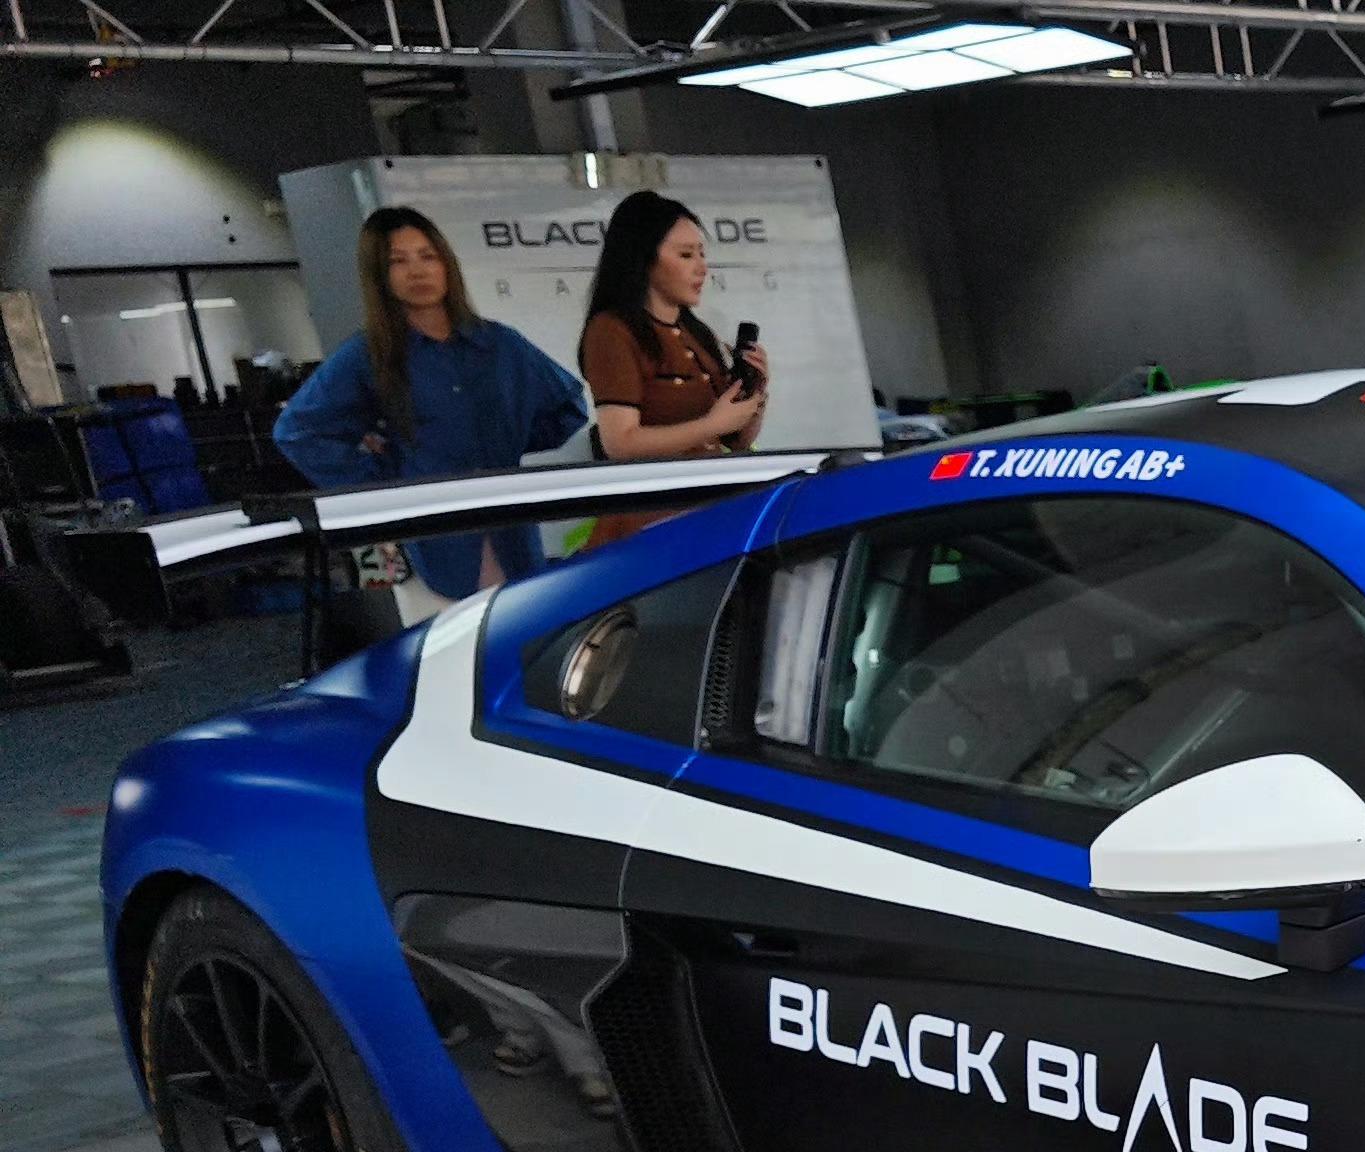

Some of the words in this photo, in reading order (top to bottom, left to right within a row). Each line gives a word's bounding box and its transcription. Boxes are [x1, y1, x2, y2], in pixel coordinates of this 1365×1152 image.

[993, 447, 1123, 481] XUNING
[1114, 449, 1186, 482] AB+
[769, 976, 1007, 1103] BLACK
